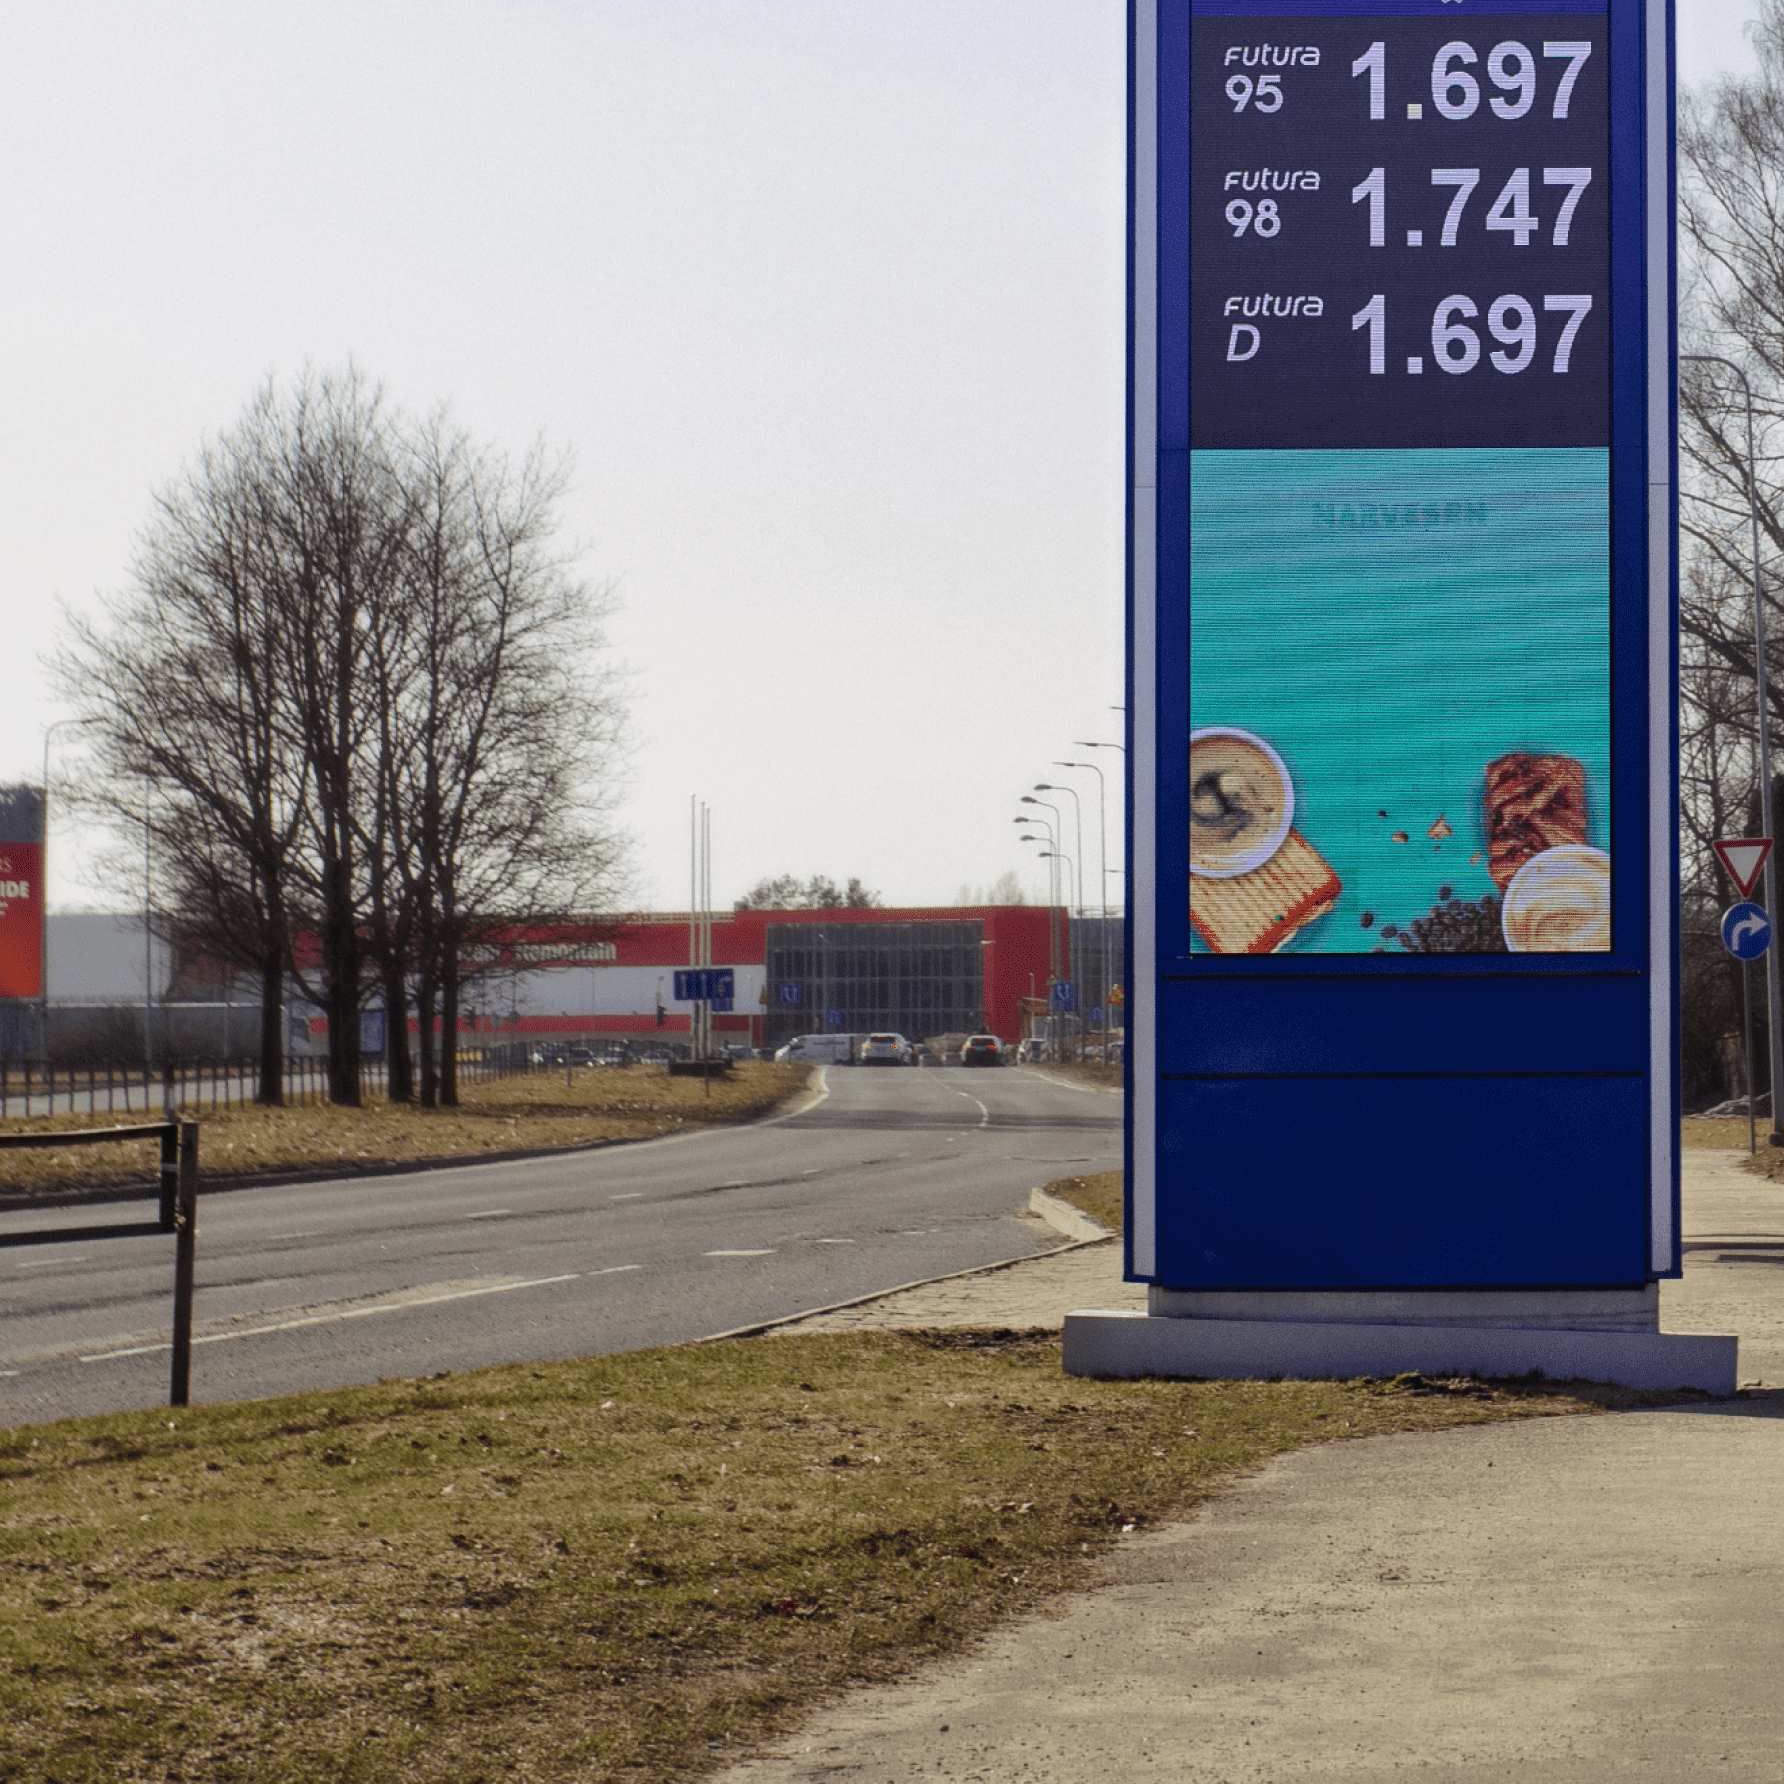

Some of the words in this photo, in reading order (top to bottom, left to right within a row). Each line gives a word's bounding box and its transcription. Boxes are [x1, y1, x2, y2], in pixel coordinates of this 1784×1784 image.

[1223, 43, 1321, 67] Futura
[1224, 74, 1284, 113] 95
[1351, 40, 1592, 120] 1.697
[1223, 167, 1321, 192] Futura
[1225, 199, 1282, 238] 98
[1351, 167, 1592, 247] 1.747
[1223, 293, 1324, 317] Futura
[1226, 323, 1261, 362] D
[1351, 294, 1593, 375] 1.697
